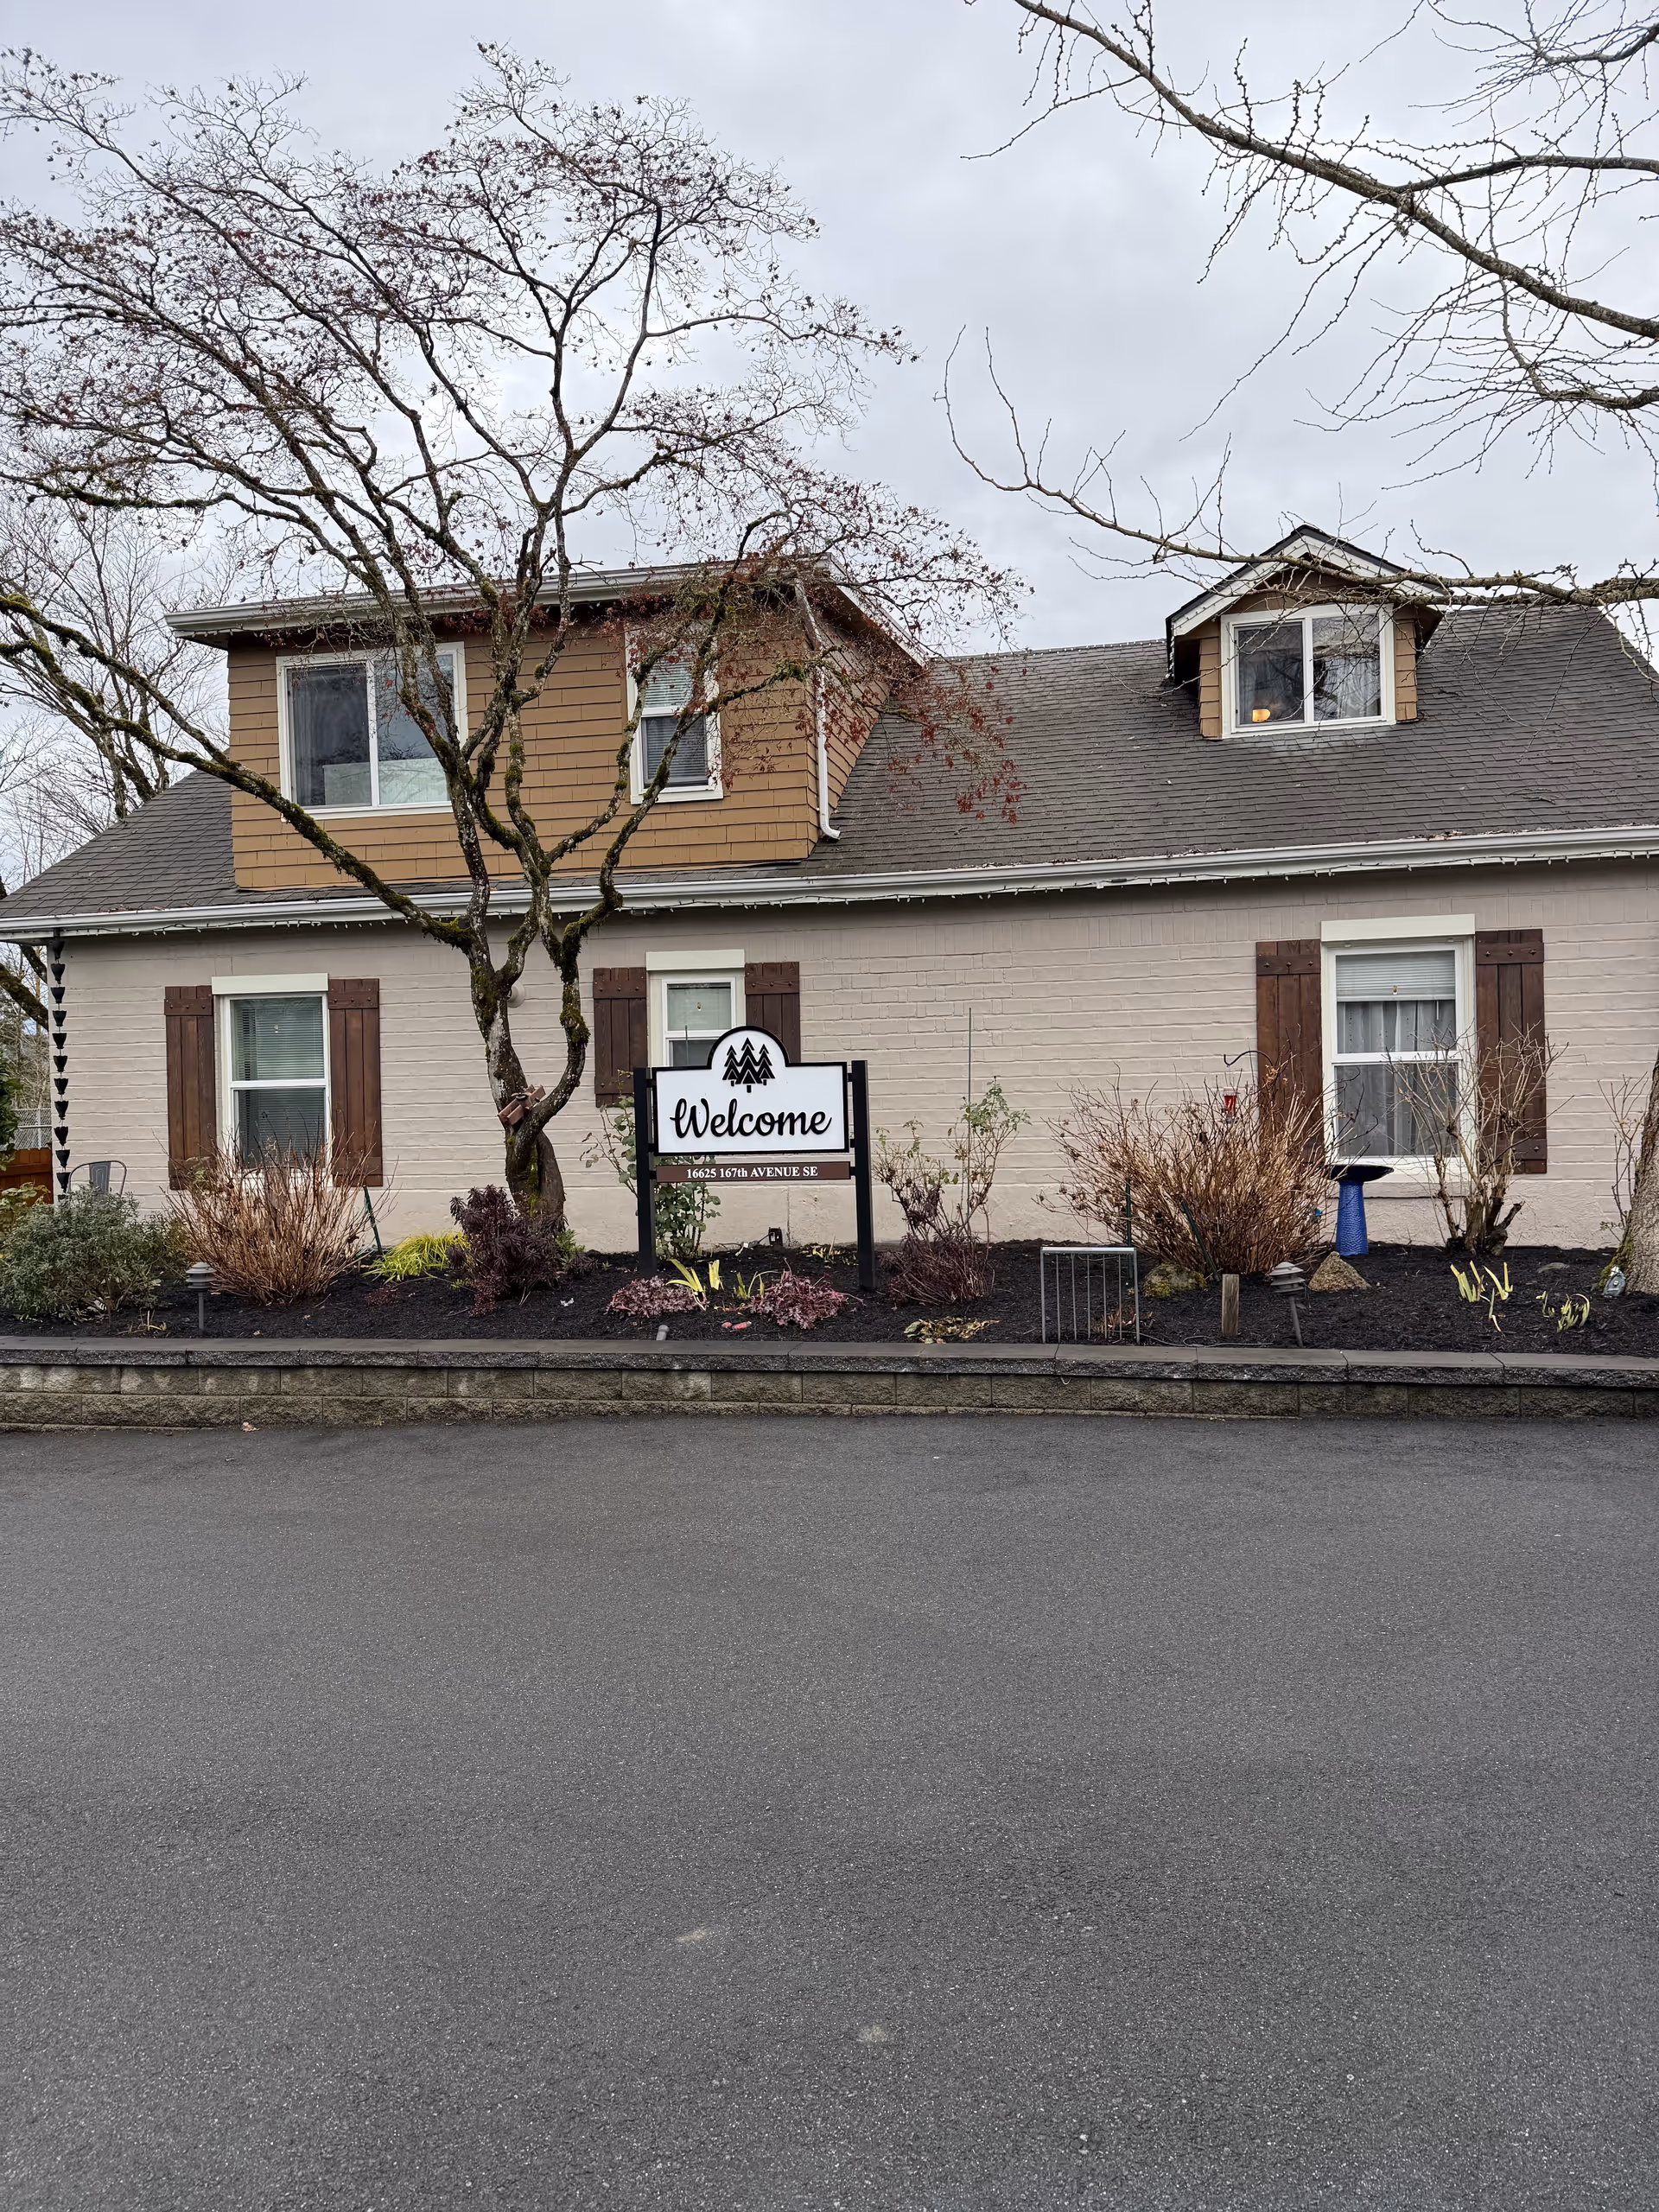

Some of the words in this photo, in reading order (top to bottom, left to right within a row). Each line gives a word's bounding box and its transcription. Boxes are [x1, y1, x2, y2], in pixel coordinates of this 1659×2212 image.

[670, 1097, 833, 1139] Welcome
[686, 1167, 716, 1179] 16625
[719, 1166, 748, 1179] 167th
[750, 1166, 800, 1178] AVENUE
[803, 1166, 818, 1177] SE
